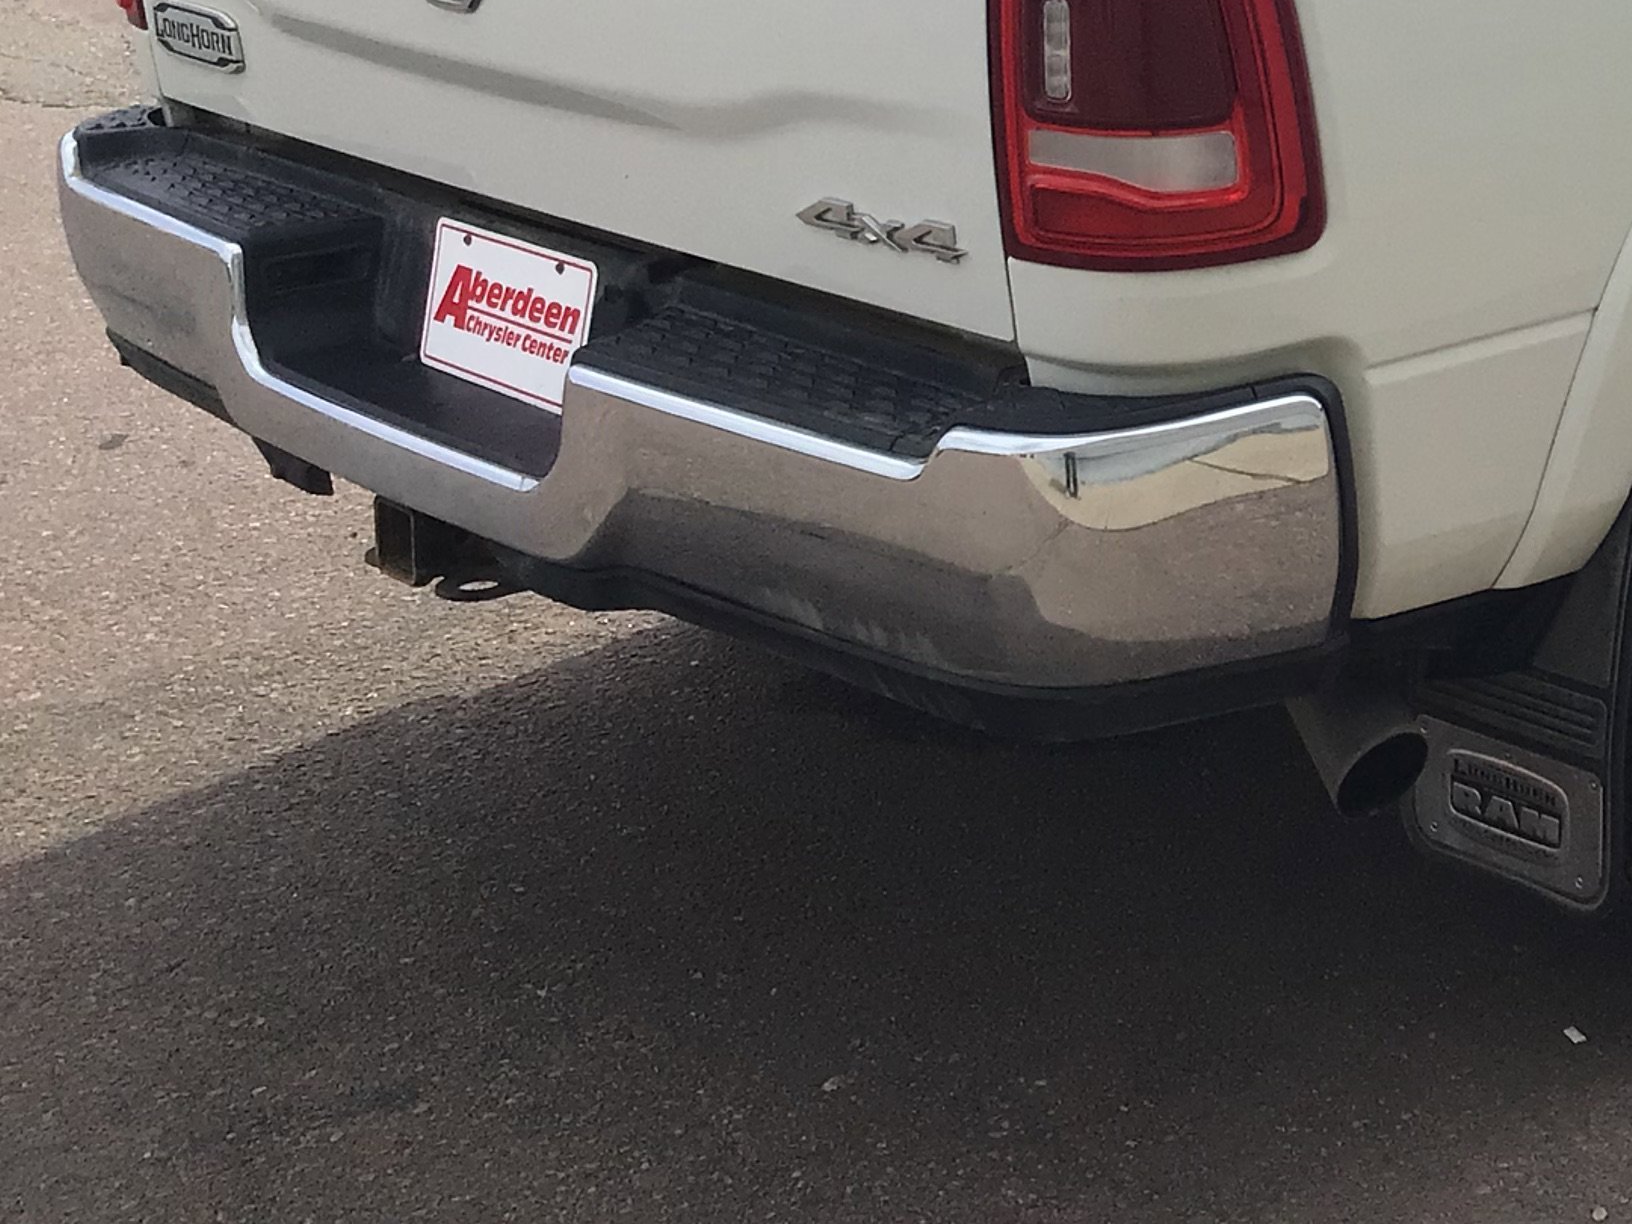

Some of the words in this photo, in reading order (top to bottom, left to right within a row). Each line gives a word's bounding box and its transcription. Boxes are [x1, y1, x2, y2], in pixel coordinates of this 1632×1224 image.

[154, 11, 234, 57] LONGHORN
[433, 263, 581, 336] Aberdeen
[465, 313, 523, 349] Chrysler
[520, 332, 570, 365] Center
[1451, 781, 1560, 848] RAM
